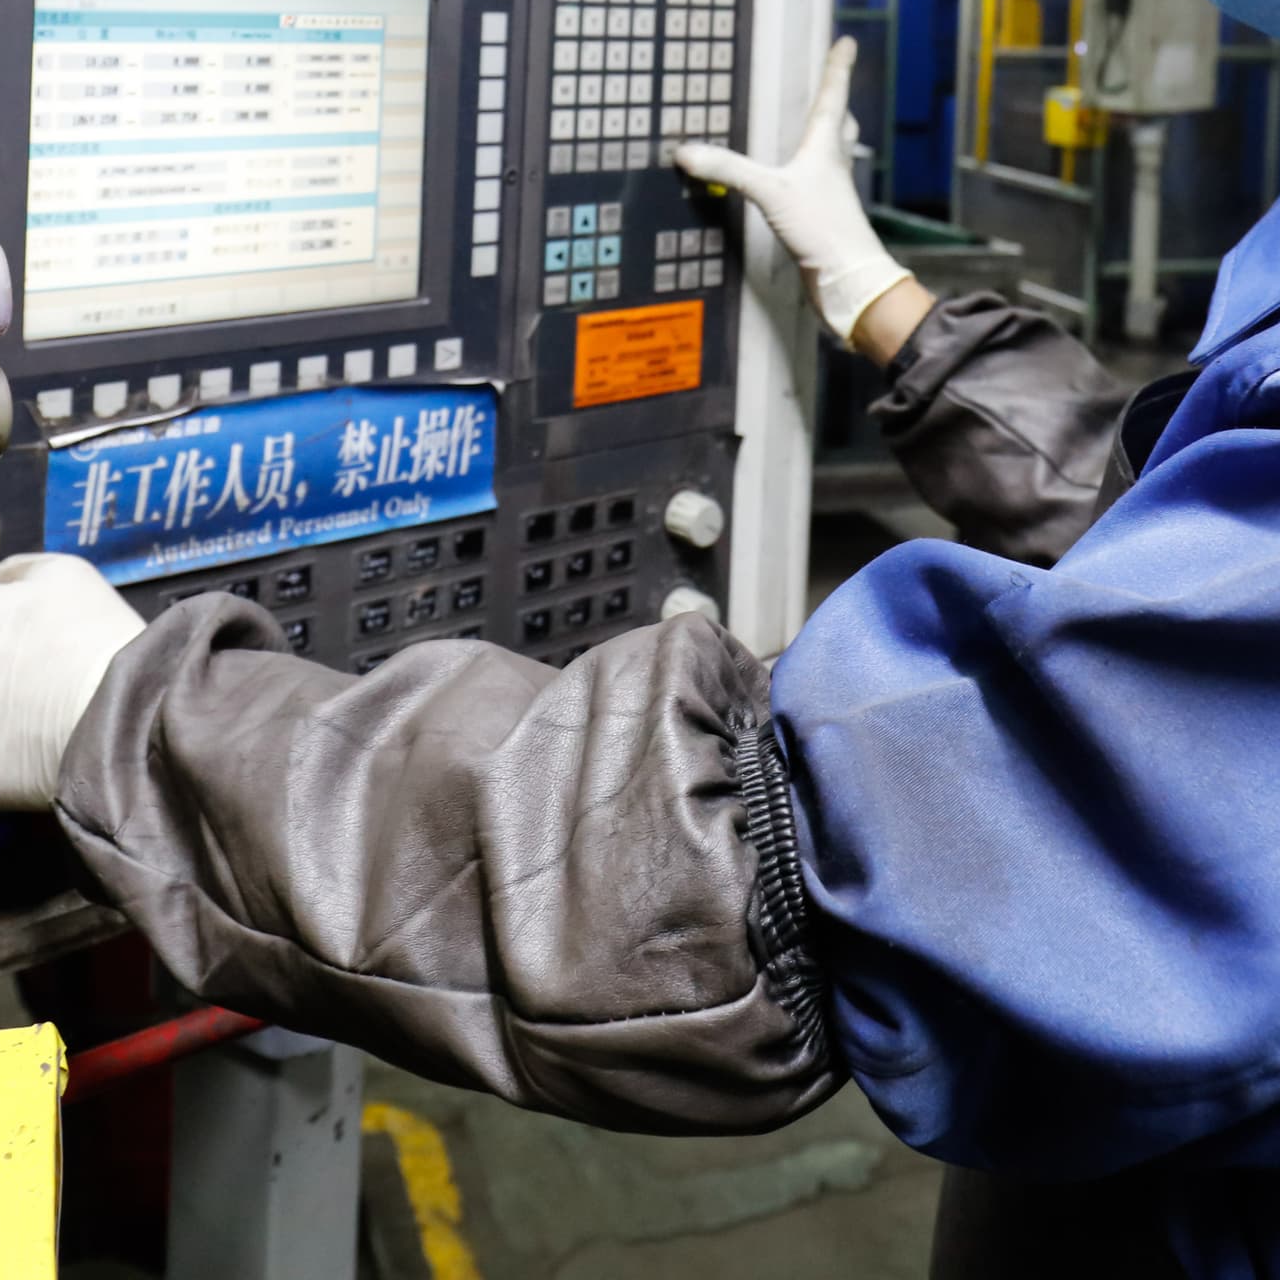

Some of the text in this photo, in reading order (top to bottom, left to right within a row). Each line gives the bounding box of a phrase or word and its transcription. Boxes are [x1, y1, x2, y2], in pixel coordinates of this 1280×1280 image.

[145, 492, 433, 569] Authorized Personnel Only
